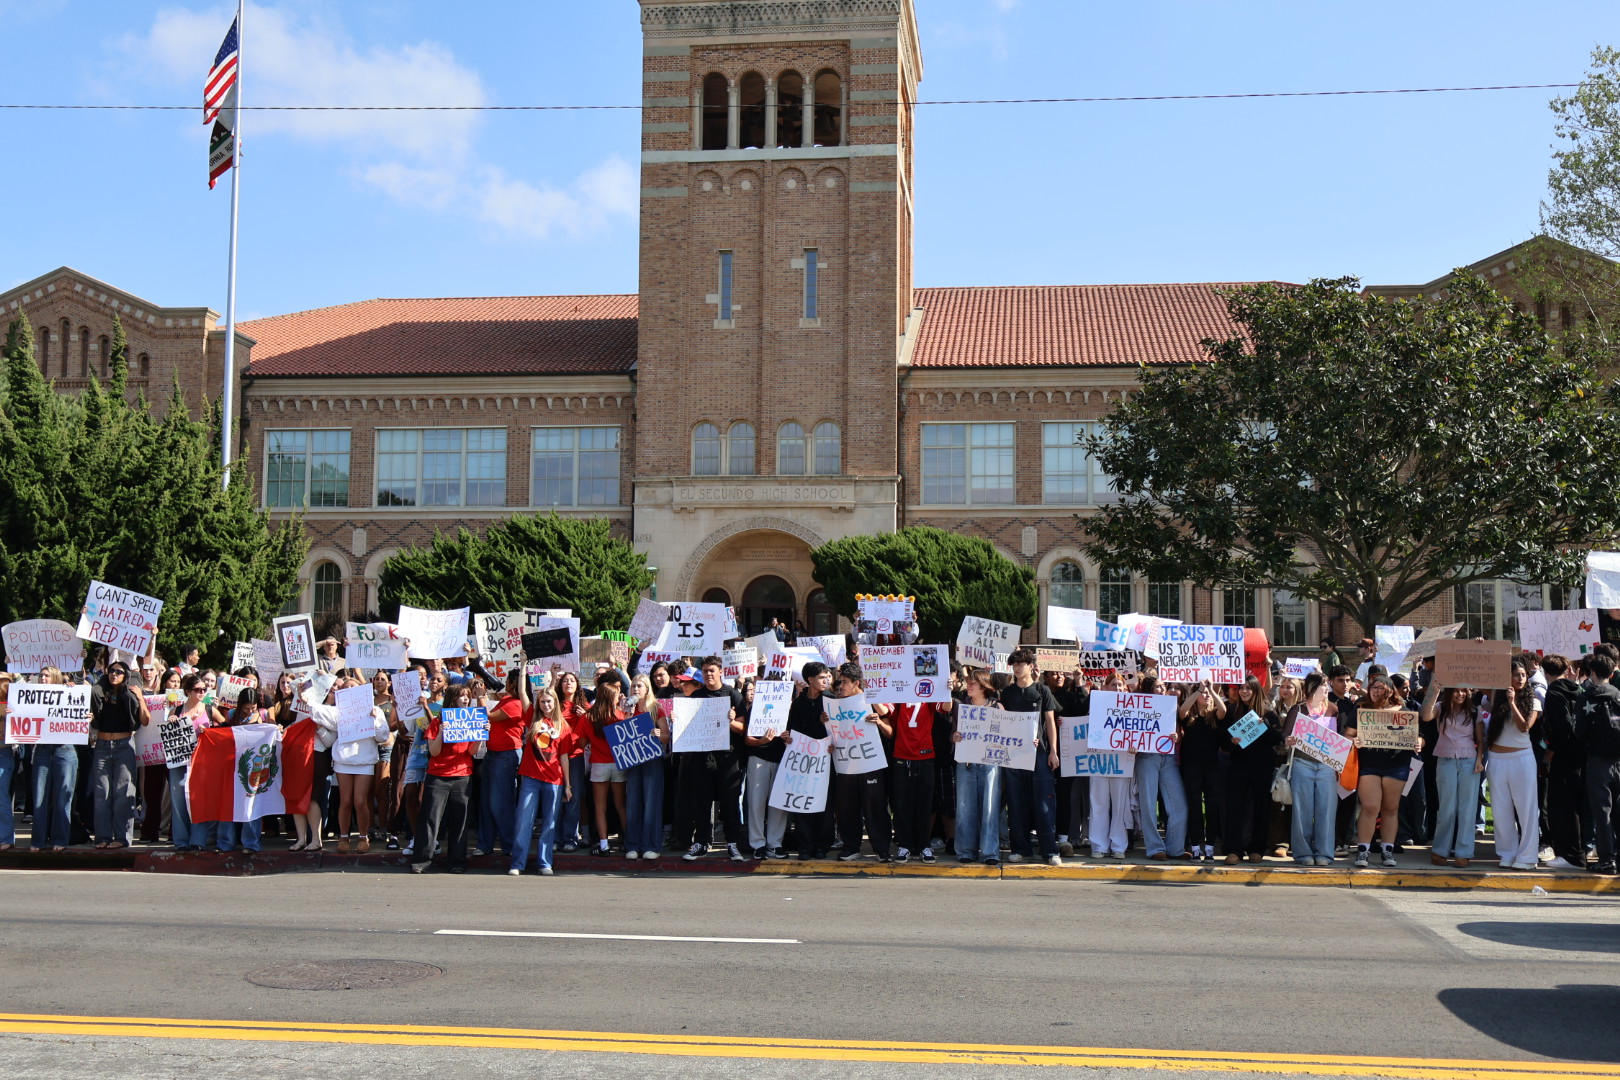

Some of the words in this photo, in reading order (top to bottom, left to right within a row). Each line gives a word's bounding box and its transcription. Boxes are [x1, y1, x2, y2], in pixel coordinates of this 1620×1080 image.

[680, 488, 694, 500] EL
[698, 488, 754, 500] SEGUNDO
[762, 488, 787, 500] HIGH
[794, 488, 847, 500] SCHOOL
[96, 586, 130, 605] CANT
[130, 596, 157, 615] SPELL
[99, 604, 144, 627] HATRED
[10, 629, 71, 643] POLITICS
[89, 621, 118, 644] RED
[122, 632, 146, 652] HAT
[357, 625, 399, 641] FUCK
[677, 622, 705, 638] IS
[984, 622, 1009, 639] ARE
[1096, 623, 1128, 645] ICE
[1162, 626, 1205, 642] JESUS
[1215, 627, 1244, 642] TOLD
[974, 636, 994, 649] ALL
[1528, 632, 1582, 645] AMERICA
[288, 642, 306, 652] COFFEE
[357, 643, 382, 658] ICE
[862, 646, 905, 656] REMEMBER
[1159, 643, 1172, 655] US
[1177, 644, 1189, 655] TO
[1192, 643, 1215, 655] LOVE
[1219, 643, 1237, 655] OUR
[12, 654, 79, 669] HUMANITY
[647, 653, 671, 662] HATE
[772, 654, 793, 668] HOT
[1107, 659, 1127, 668] FOR
[1160, 656, 1198, 667] NEIGHBOR
[1202, 656, 1220, 666] NOT
[1228, 656, 1240, 668] TO
[724, 666, 739, 677] FALL
[742, 663, 755, 674] FOR
[1161, 668, 1200, 682] DEPORT
[1210, 669, 1242, 683] THEM!
[229, 676, 252, 686] HATE
[773, 682, 792, 692] WAS
[865, 677, 888, 688] KNEE
[18, 690, 64, 705] PROTECT
[1116, 694, 1153, 708] HATE
[48, 708, 88, 719] FAMILIES
[453, 708, 483, 720] LOVE
[828, 702, 867, 722] Lokey
[906, 702, 922, 728] 7
[961, 706, 987, 721] ICE
[1107, 709, 1136, 717] never
[1138, 710, 1162, 719] made
[10, 718, 45, 735] NOT
[50, 722, 89, 734] BOARDERS
[462, 721, 474, 729] ACT
[614, 718, 643, 743] DUE
[1104, 717, 1160, 732] AMERICA
[160, 729, 183, 740] MAKE
[183, 725, 194, 735] ME
[443, 729, 486, 741] RESISTANCE
[832, 724, 865, 743] Fuck
[1110, 729, 1155, 750] GREAT
[1294, 719, 1350, 754] ABOLISH
[163, 735, 192, 749] REPEAT
[795, 734, 832, 756] HOT
[983, 734, 1024, 747] STREETS
[1304, 733, 1331, 755] ICE
[612, 735, 662, 770] PROCESS
[836, 741, 878, 761] ICE
[1302, 744, 1318, 757] KIDS
[1322, 755, 1343, 772] CAGES
[785, 751, 827, 773] PEOPLE
[1075, 754, 1123, 775] EQUAL
[784, 773, 818, 795] MELT
[783, 793, 814, 810] ICE
